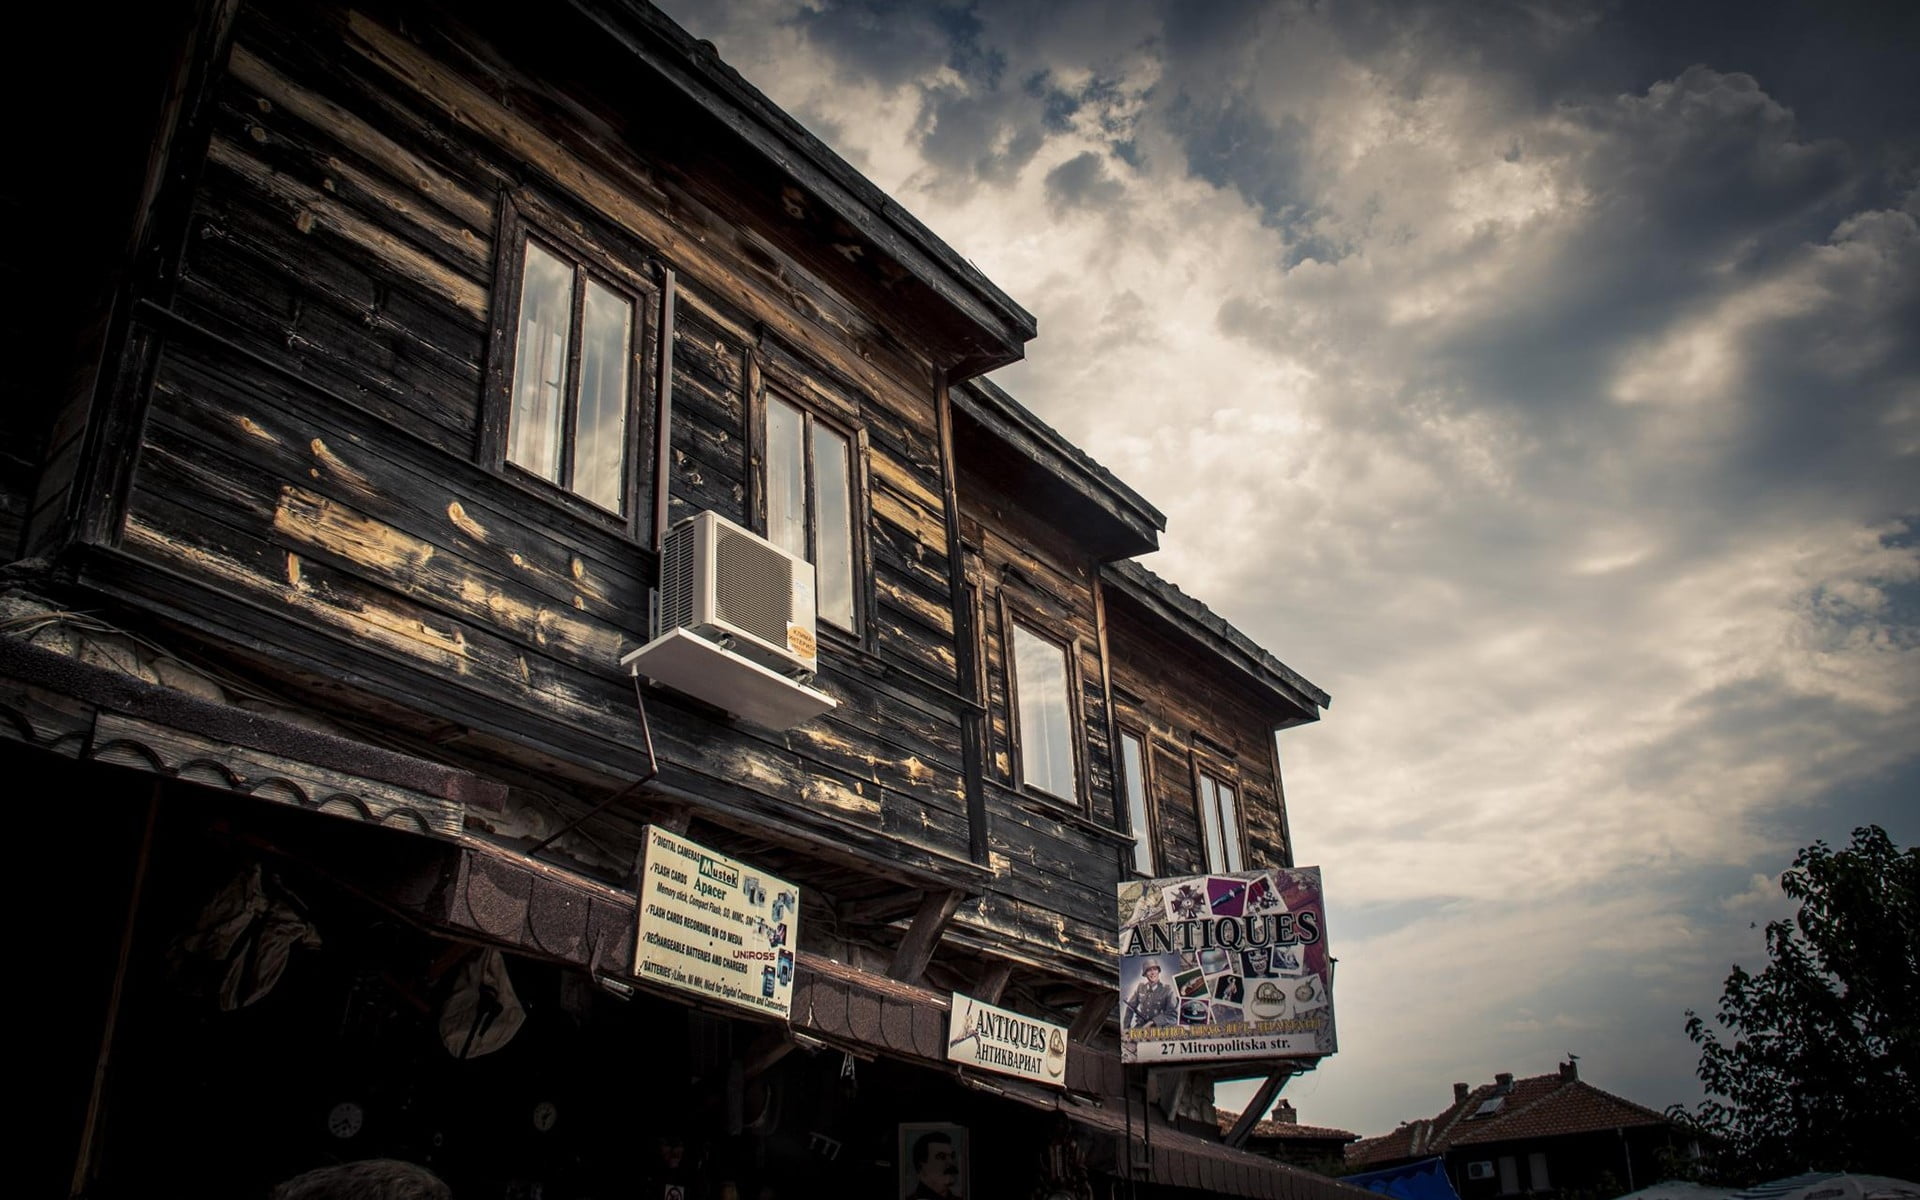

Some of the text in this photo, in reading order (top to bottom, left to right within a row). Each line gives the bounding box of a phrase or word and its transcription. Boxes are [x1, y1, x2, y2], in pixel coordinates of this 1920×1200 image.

[657, 836, 700, 863] DIGITAL CAMERAS
[654, 863, 687, 885] FLASH CARDS
[700, 859, 738, 886] Mustek
[657, 882, 676, 899] Memory
[694, 877, 727, 900] Apacer
[650, 904, 666, 919] FLASH
[667, 910, 683, 925] CARDS
[683, 917, 711, 935] RECORDING
[711, 927, 719, 938] ON
[727, 932, 743, 946] MEDIA
[1124, 912, 1321, 956] ANTIQUES
[647, 931, 748, 974] RECHARGEABLE BATTERIES AND CHARGERS
[644, 960, 671, 978] BATTERIES
[976, 1010, 1046, 1052] ANTIQUES
[975, 1044, 1042, 1074] АНТИКВАРИАТ
[1162, 1039, 1290, 1055] 27 Mitropolitska str.
